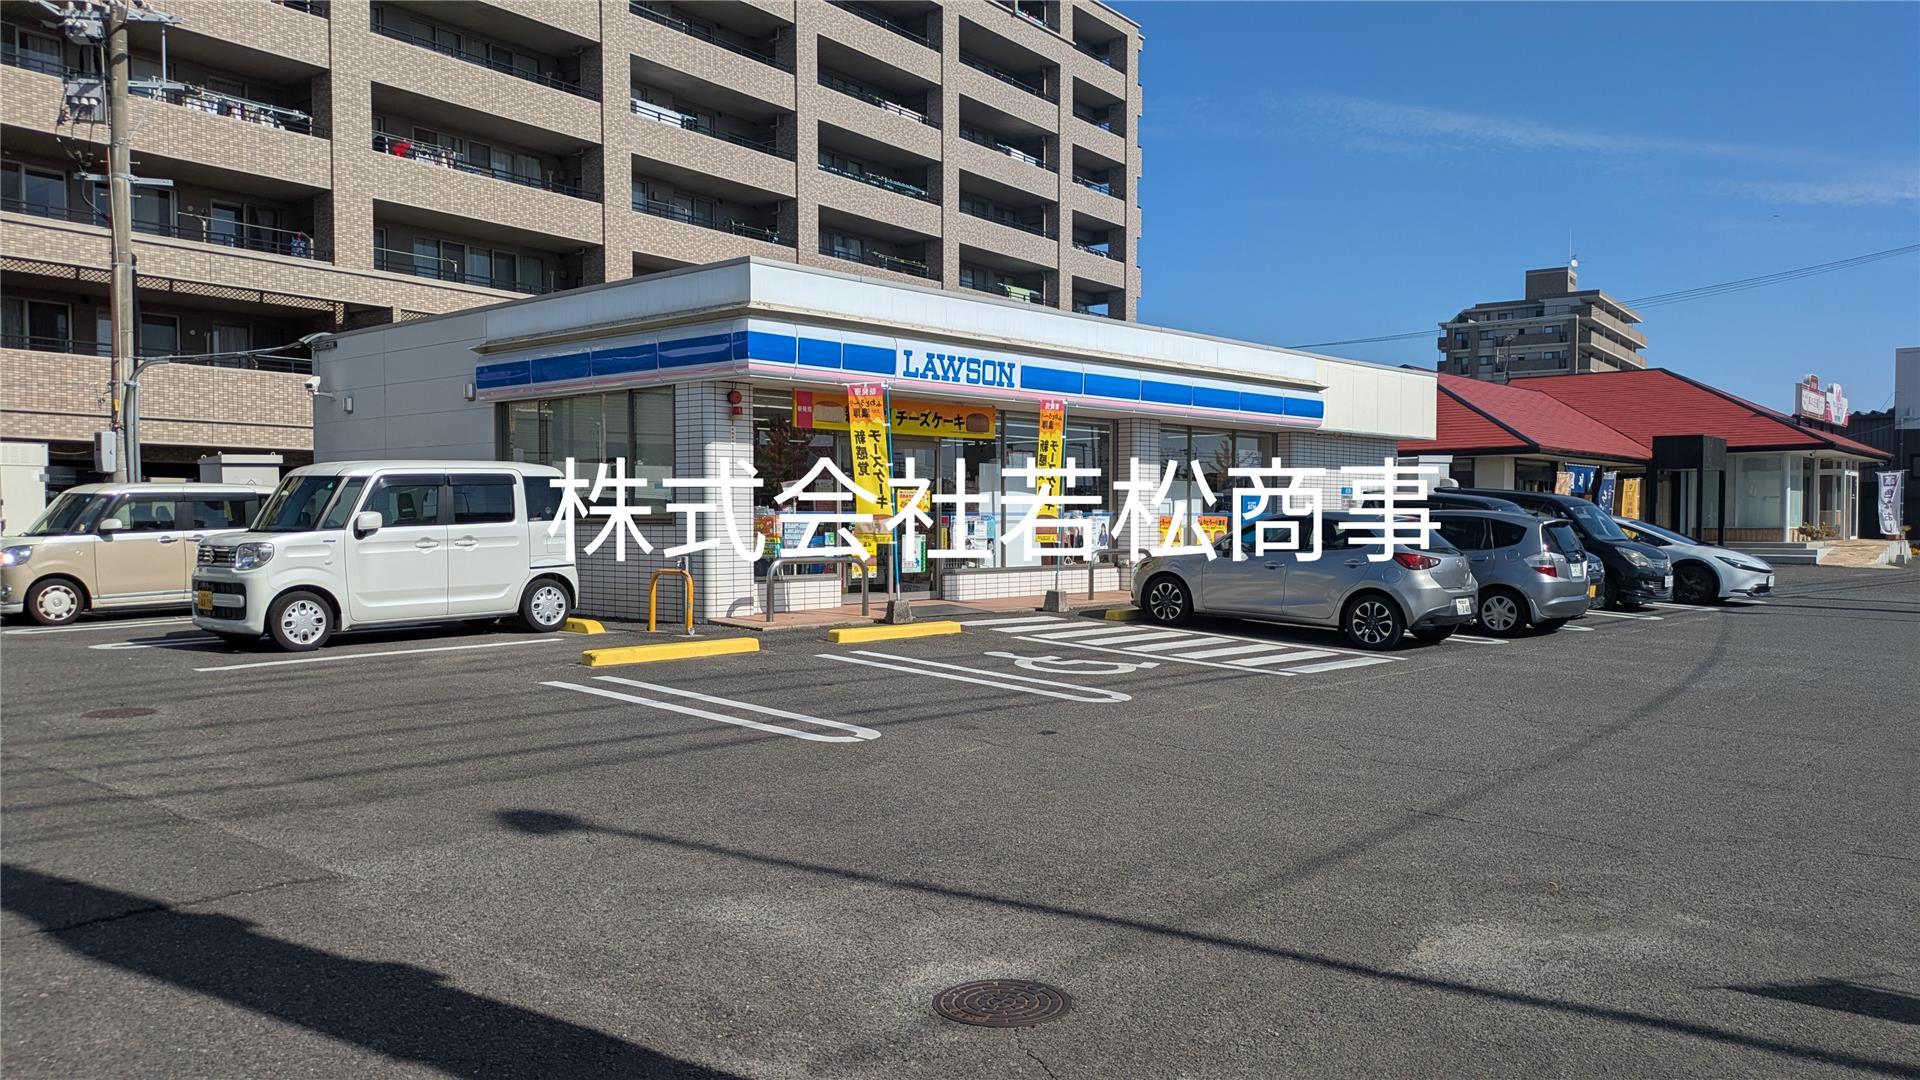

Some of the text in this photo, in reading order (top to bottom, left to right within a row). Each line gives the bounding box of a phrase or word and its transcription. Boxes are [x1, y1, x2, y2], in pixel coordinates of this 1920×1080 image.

[903, 349, 1015, 388] LAWSON
[895, 410, 965, 431] チーズケーキ
